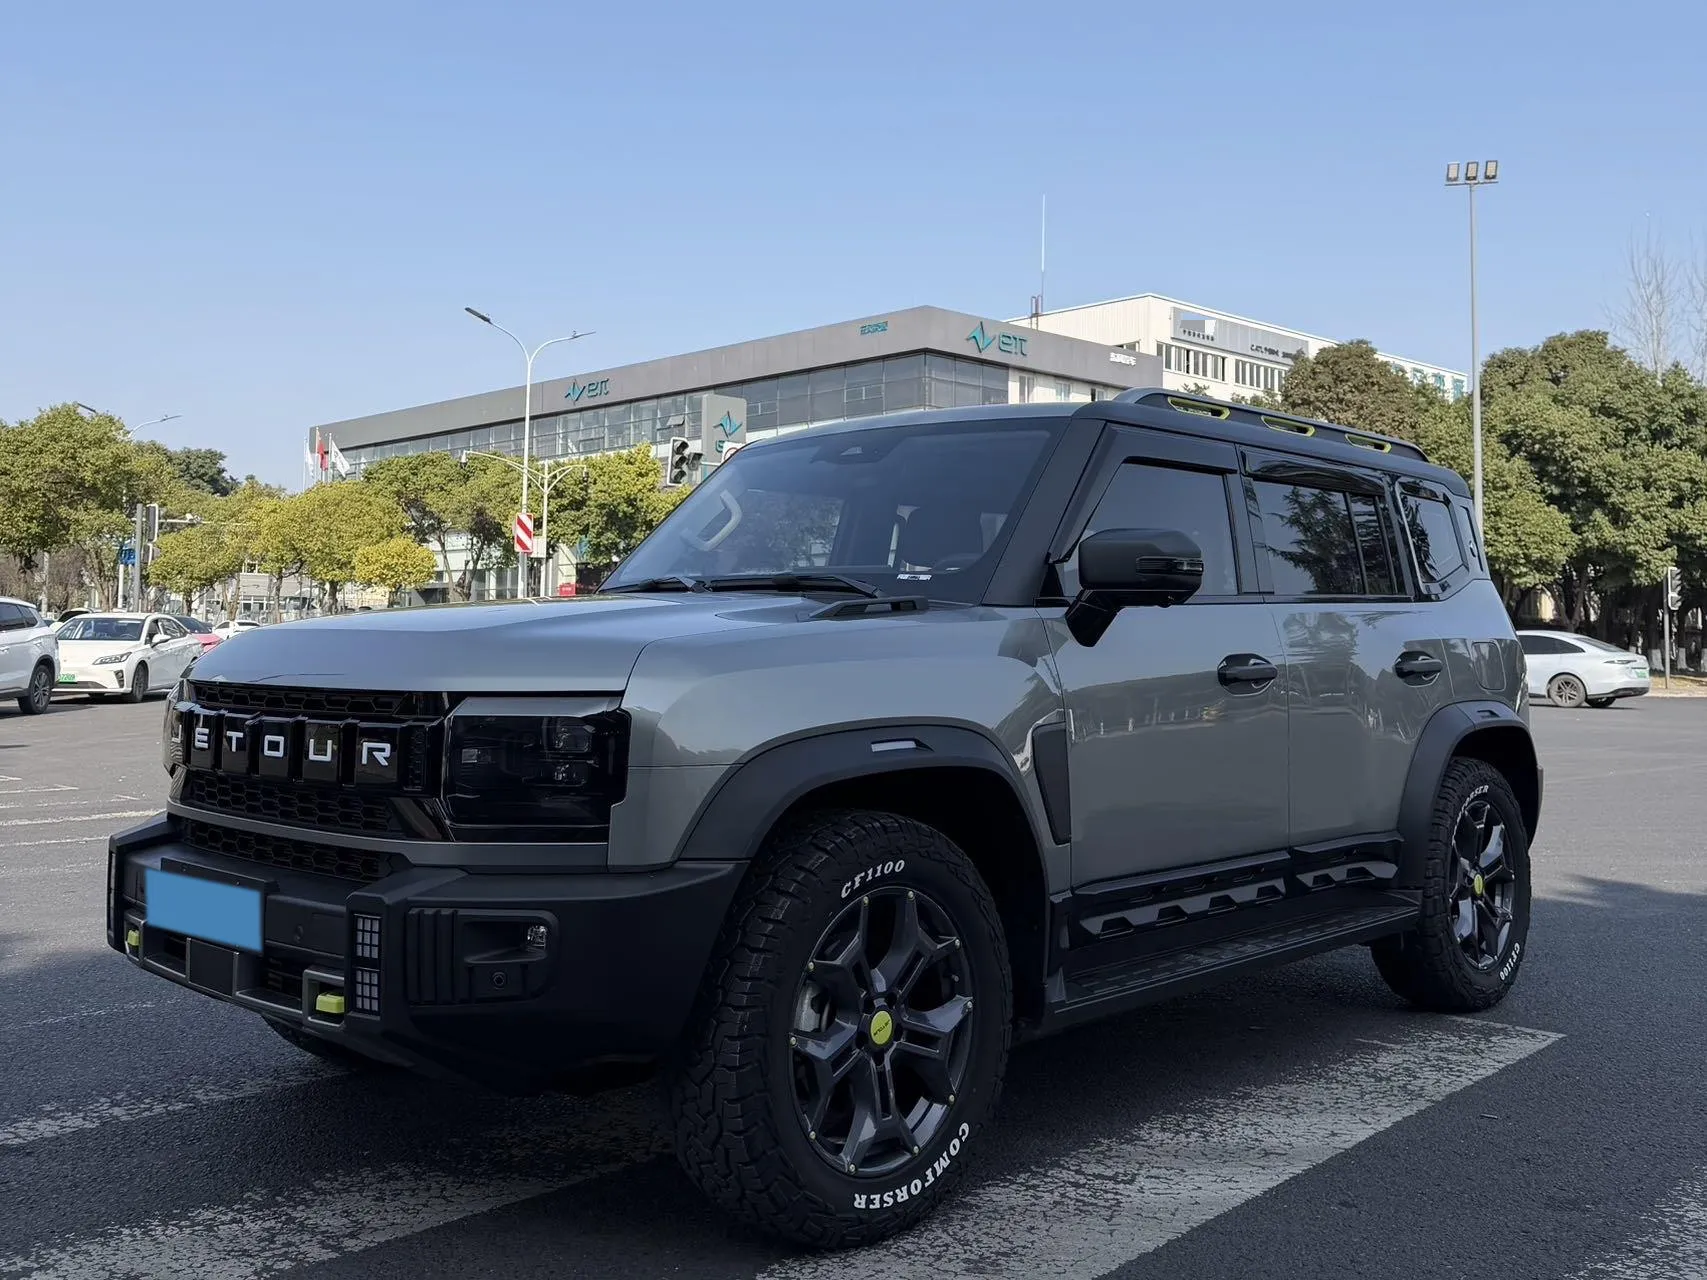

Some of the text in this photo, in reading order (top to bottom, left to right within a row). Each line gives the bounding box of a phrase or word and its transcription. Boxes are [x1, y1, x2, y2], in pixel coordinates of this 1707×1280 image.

[171, 724, 391, 767] JETOUR
[840, 859, 905, 899] CF1100
[1499, 942, 1521, 981] CF1100
[853, 1122, 970, 1210] COMFORSER
